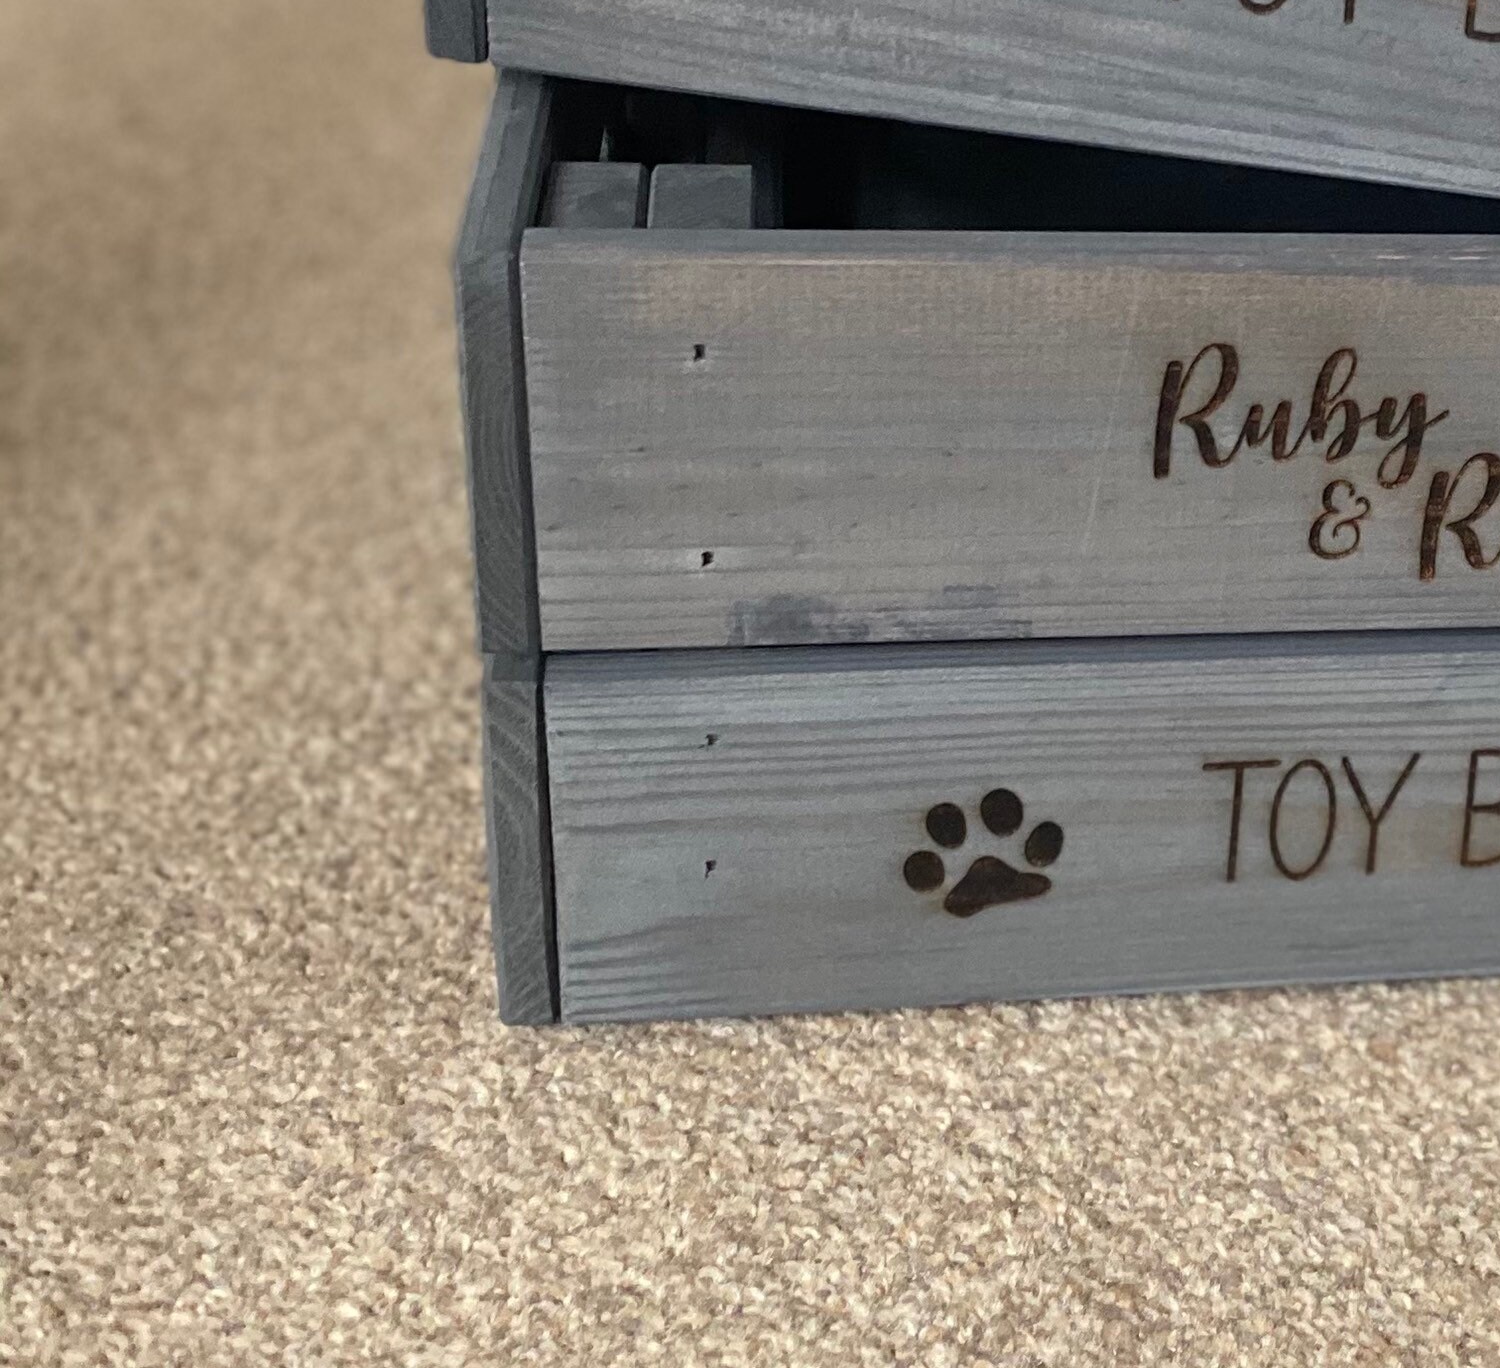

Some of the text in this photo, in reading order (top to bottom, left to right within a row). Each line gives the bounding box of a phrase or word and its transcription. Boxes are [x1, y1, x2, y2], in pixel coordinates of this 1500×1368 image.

[1153, 342, 1450, 489] Ruby
[1308, 479, 1371, 559] &
[1202, 752, 1421, 882] TOY
